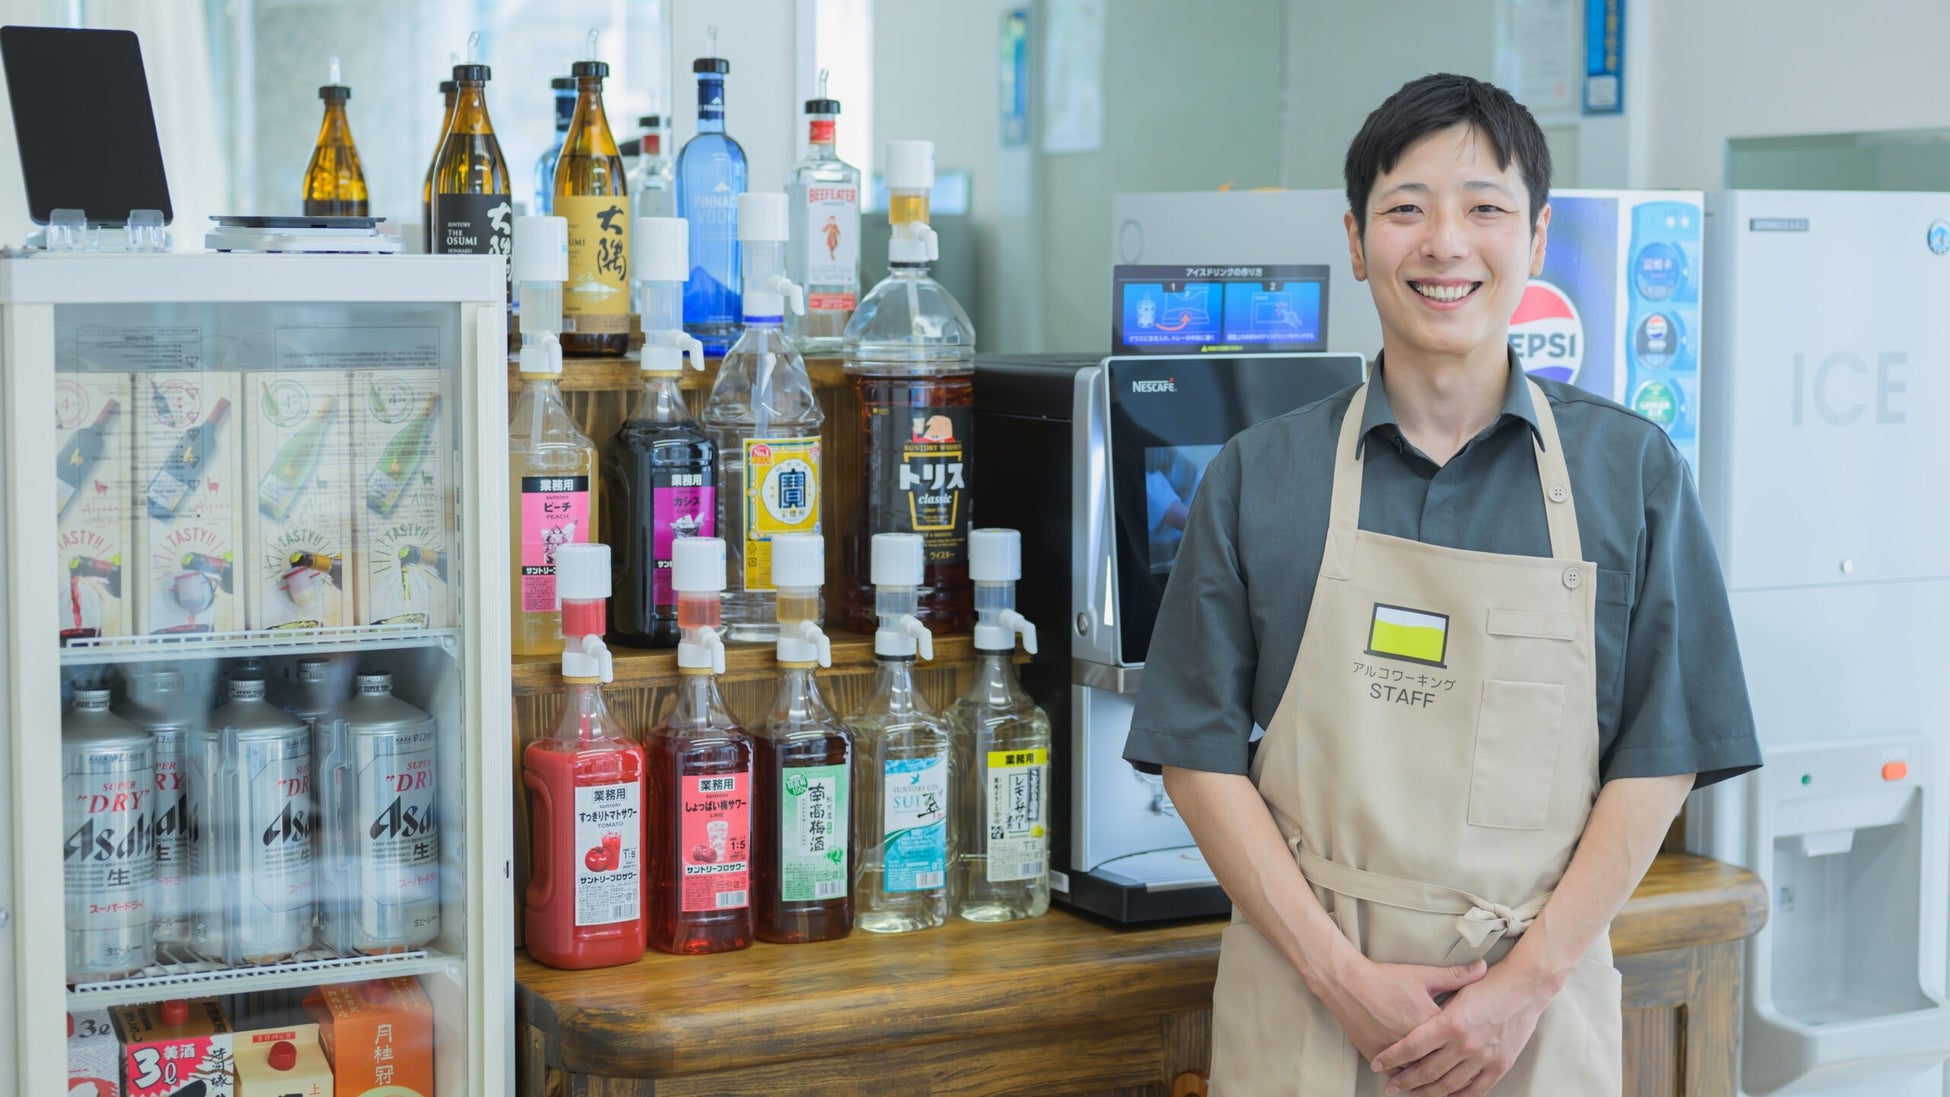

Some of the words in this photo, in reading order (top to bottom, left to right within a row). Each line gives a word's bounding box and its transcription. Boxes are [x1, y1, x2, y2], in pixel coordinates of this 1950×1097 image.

[692, 196, 738, 208] PINNAC
[809, 188, 856, 203] BEEFEATER
[697, 209, 738, 224] VODK
[446, 236, 477, 246] OSUMI
[597, 205, 628, 281] 大隅
[1186, 268, 1263, 277] アイスドリンクの作り方
[1171, 283, 1176, 291] 1
[1270, 282, 1276, 291] 2
[1792, 351, 1908, 427] ICE
[904, 444, 938, 452] SUNTORY
[671, 474, 702, 486] 業務用
[900, 463, 965, 490] トリス
[540, 479, 574, 492] 業務用
[674, 496, 700, 507] カシス
[918, 493, 952, 504] classic
[544, 502, 572, 513] ピーチ
[166, 527, 217, 547] TASTY!!
[277, 529, 323, 548] TASTY!!
[384, 523, 429, 542] TASTY!!
[1352, 662, 1457, 691] アルコワーキング
[1369, 682, 1436, 709] STAFF
[1006, 753, 1034, 765] 業務用
[102, 781, 137, 791] SUPER
[701, 778, 733, 791] 業務用
[927, 783, 939, 791] GIN
[594, 788, 626, 801] 業務用
[686, 799, 746, 812] しょっぱい梅サワー
[893, 795, 920, 808] SUI
[1014, 776, 1026, 830] レモンサワー
[579, 808, 637, 823] すっきりトマトサワー
[808, 782, 825, 852] 南高梅酒
[413, 842, 430, 860] 生
[731, 841, 746, 850] 1:5
[624, 851, 636, 859] 1:5
[108, 868, 130, 886] 生
[164, 1044, 196, 1060] 美酒
[373, 1023, 394, 1086] 月桂冠
[309, 1083, 321, 1096] 上
